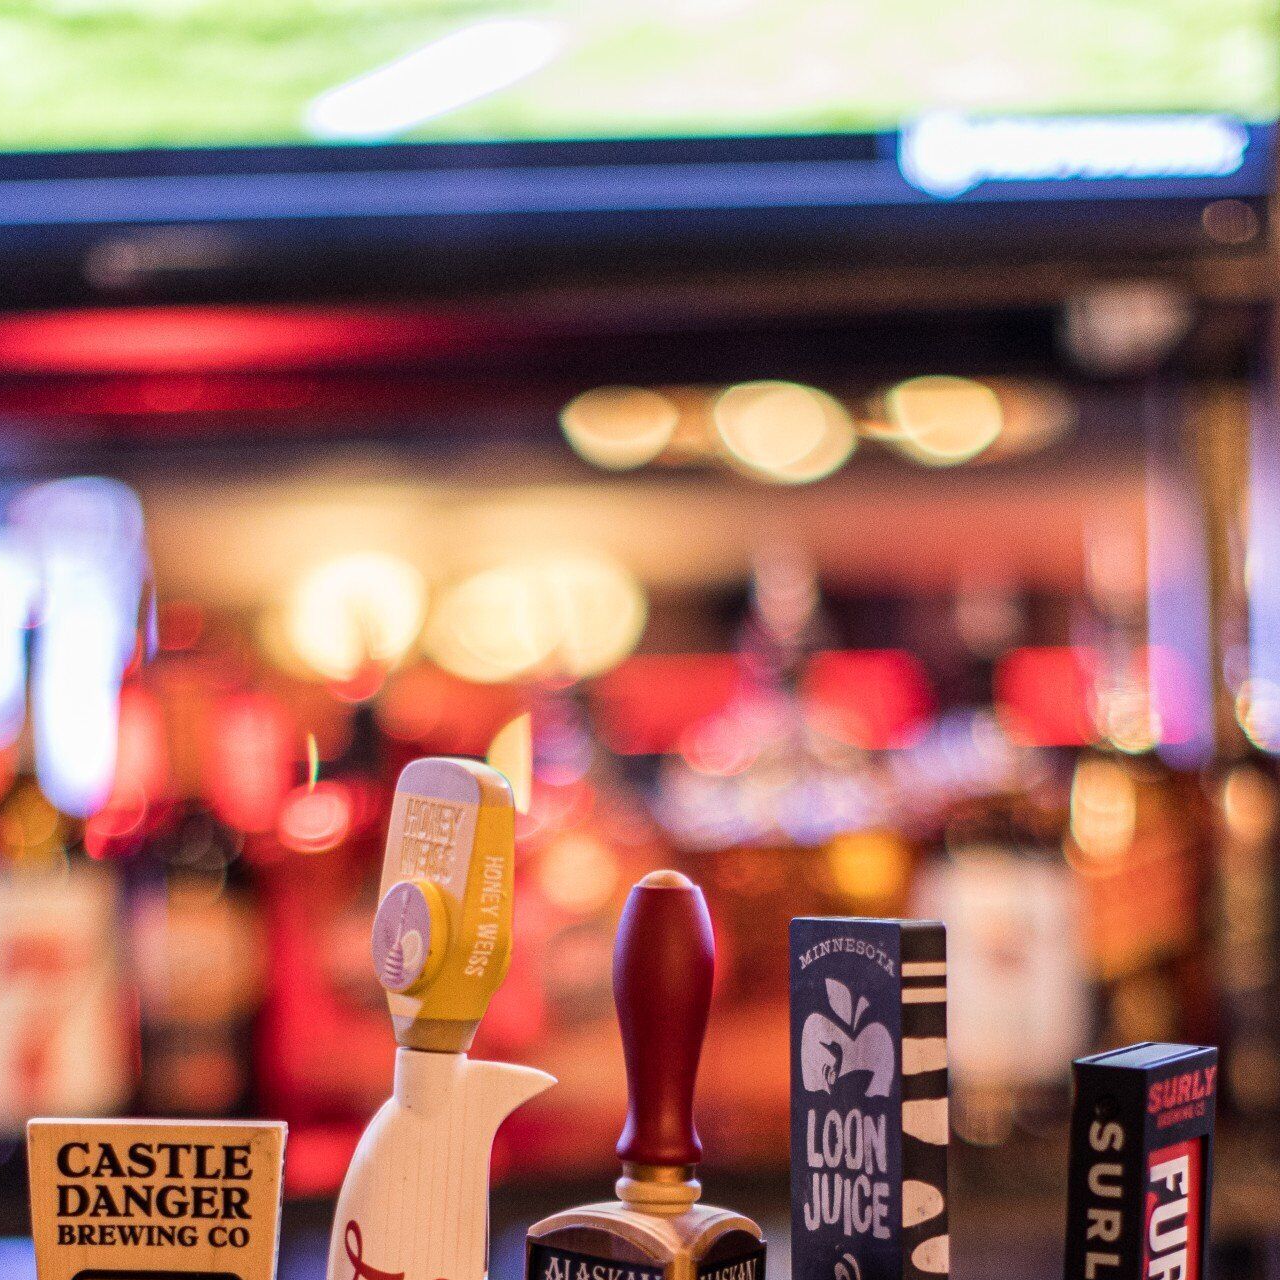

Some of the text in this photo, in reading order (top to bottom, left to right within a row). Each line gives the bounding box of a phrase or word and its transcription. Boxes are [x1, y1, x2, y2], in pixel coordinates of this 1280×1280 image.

[465, 854, 505, 977] HONEY WEISS
[799, 938, 895, 977] MINNESOTA
[1147, 1064, 1217, 1114] SURLY
[56, 1142, 253, 1182] CASTLE
[806, 1108, 888, 1175] LOON
[56, 1184, 252, 1221] DANGER
[804, 1172, 892, 1240] JUICE
[58, 1225, 251, 1249] BREWING CO
